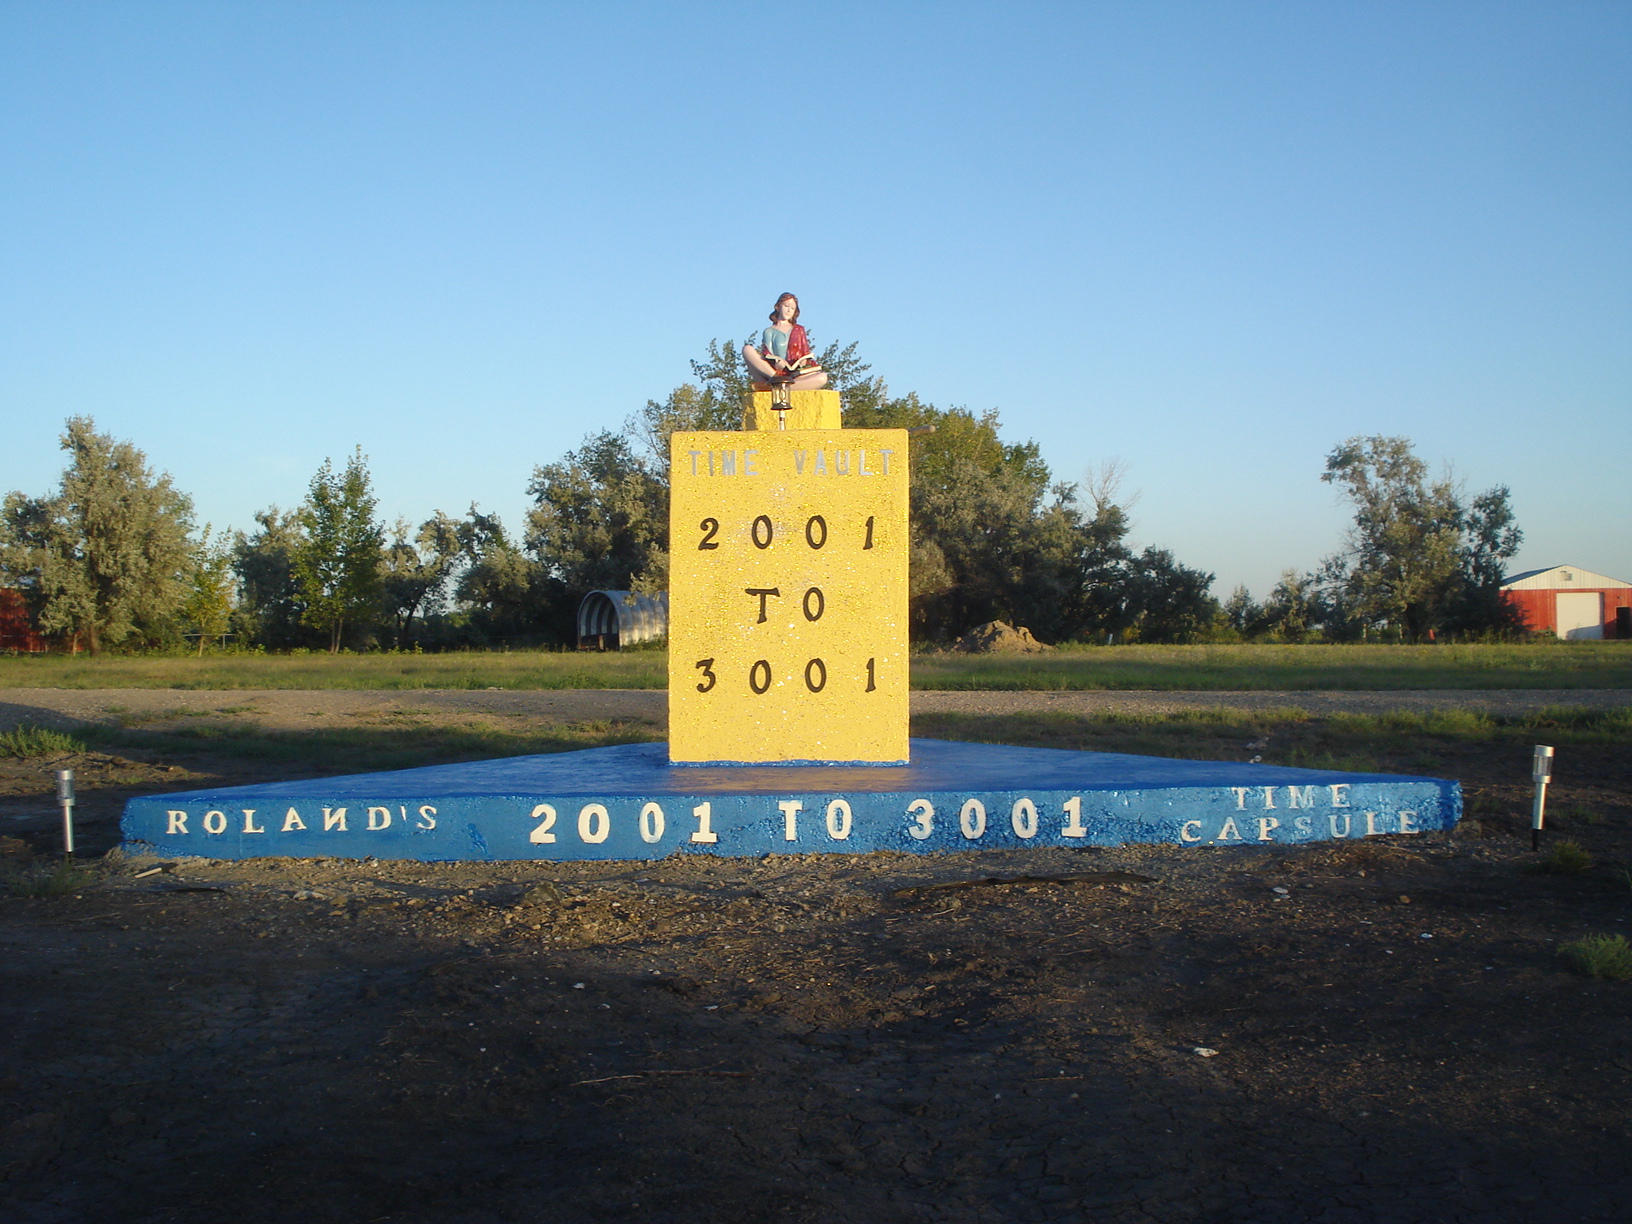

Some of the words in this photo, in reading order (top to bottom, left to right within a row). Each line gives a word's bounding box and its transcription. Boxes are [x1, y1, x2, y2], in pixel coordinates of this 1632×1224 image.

[688, 450, 759, 476] TIME
[794, 450, 894, 476] VAULT
[698, 514, 874, 550] 2001
[745, 587, 825, 624] TO
[695, 657, 876, 694] 3001
[1231, 783, 1351, 811] TIME
[166, 805, 438, 835] ROLAND'S
[529, 801, 718, 844] 2001
[778, 799, 852, 841] TO
[907, 796, 1088, 839] 3001
[1180, 810, 1419, 842] CAPSULE
